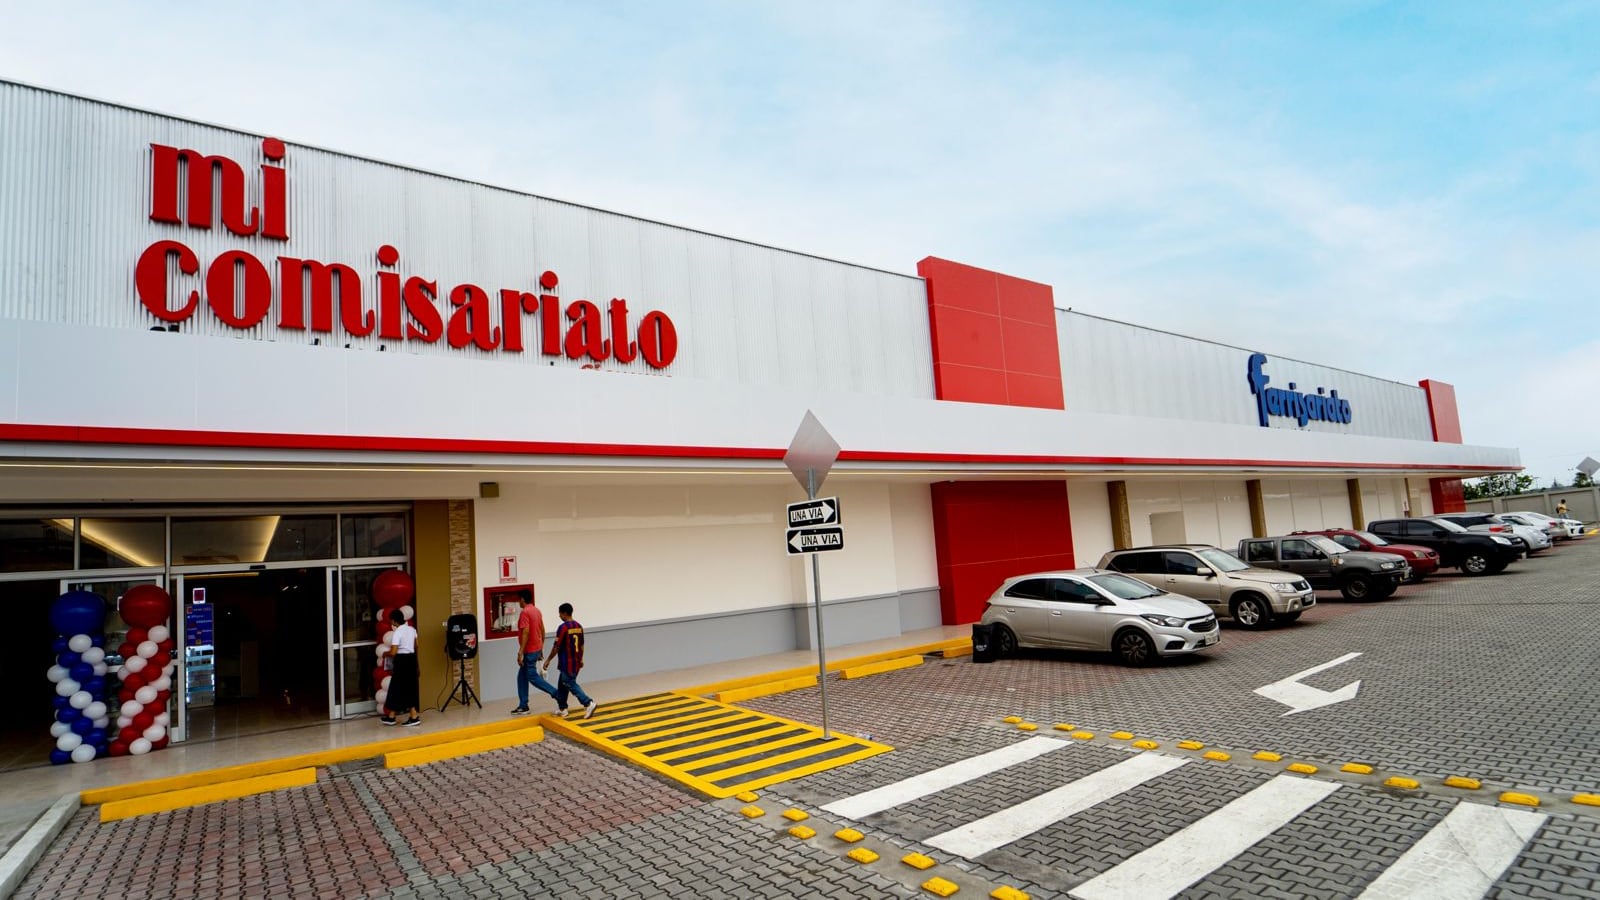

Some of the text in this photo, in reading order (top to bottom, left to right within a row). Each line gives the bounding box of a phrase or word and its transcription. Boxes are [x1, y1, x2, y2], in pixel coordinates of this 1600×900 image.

[150, 137, 289, 241] mi
[135, 240, 679, 370] comisariato
[1247, 352, 1352, 428] ferrisariato
[792, 507, 824, 521] UNA VIA
[801, 534, 839, 546] UNA VIA
